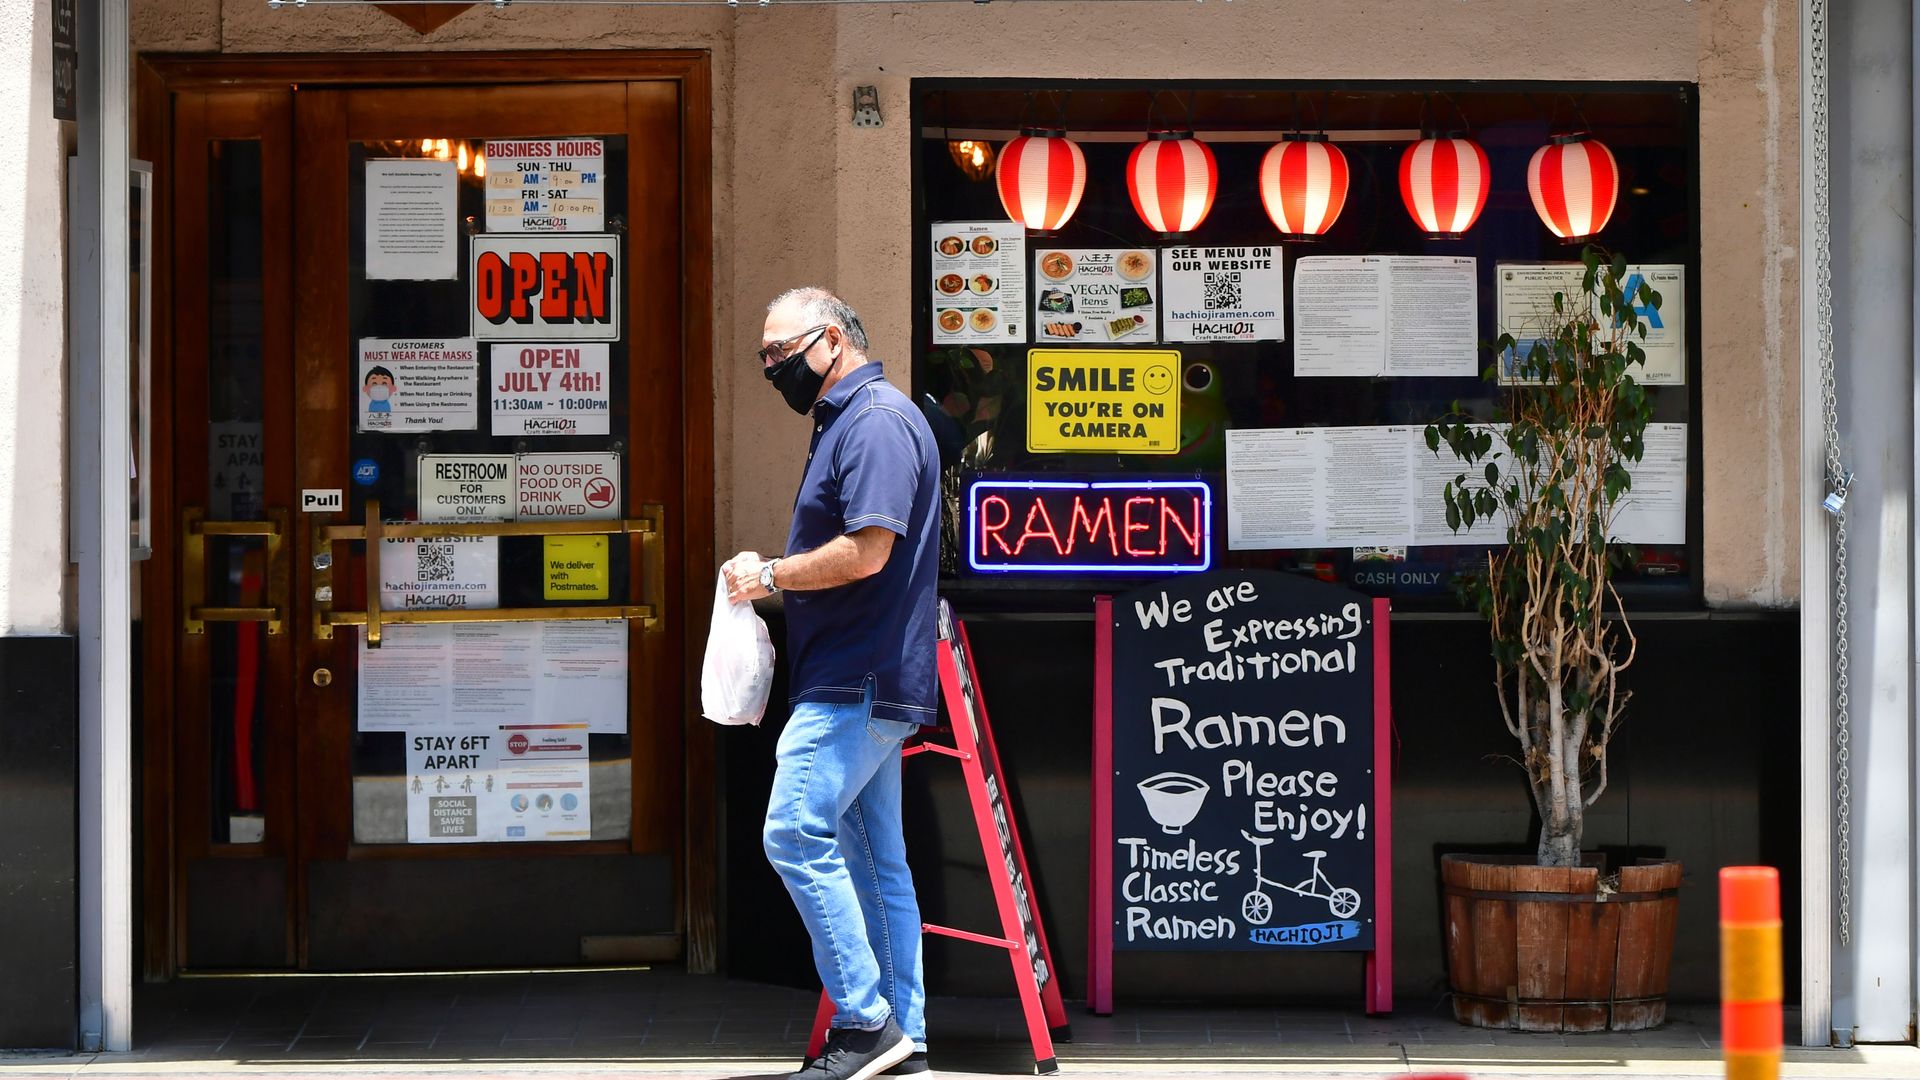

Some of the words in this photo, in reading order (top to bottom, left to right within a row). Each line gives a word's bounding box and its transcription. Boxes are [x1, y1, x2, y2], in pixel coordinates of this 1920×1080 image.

[487, 143, 552, 157] BUSINESS
[557, 142, 601, 156] HOURS
[517, 162, 539, 171] SUN
[549, 162, 572, 171] THU
[523, 174, 539, 184] AM
[581, 173, 596, 183] PM
[522, 190, 539, 199] FRI
[548, 190, 568, 199] SAT
[523, 201, 539, 211] AM
[582, 205, 594, 213] PM
[522, 217, 567, 227] HACHIOJI
[1080, 254, 1113, 263] 八王子
[1172, 249, 1198, 259] SEE
[1204, 248, 1246, 258] MENU
[1252, 247, 1271, 257] ON
[1172, 261, 1201, 271] OUR
[1208, 260, 1271, 270] WEBSITE
[477, 251, 612, 324] OPEN
[1070, 284, 1120, 295] VEGAN
[1081, 297, 1109, 306] items
[1610, 273, 1664, 328] A
[1172, 310, 1275, 320] hachiojiramen.com
[1192, 322, 1254, 336] HACHIOJI
[364, 351, 388, 360] MUST
[391, 351, 416, 360] WEAR
[419, 351, 440, 360] FACE
[442, 351, 472, 360] MASKS
[520, 348, 580, 369] OPEN
[498, 372, 552, 392] JULY
[560, 372, 601, 391] 4th!
[1035, 366, 1135, 392] SMILE
[493, 399, 543, 410] 11:30AM
[559, 398, 608, 410] 10:00PM
[1044, 401, 1123, 418] YOU'RE
[1132, 402, 1164, 418] ON
[524, 419, 577, 431] HACHIOJI
[1059, 422, 1148, 438] CAMERA
[218, 434, 258, 448] STAY
[357, 466, 376, 475] ADT
[435, 463, 507, 480] RESTROOM
[519, 464, 539, 475] NO
[544, 464, 603, 475] OUTSIDE
[460, 484, 483, 493] FOR
[520, 478, 558, 489] FOOD
[562, 478, 582, 488] OR
[304, 495, 339, 506] Pull
[437, 495, 506, 505] CUSTOMERS
[520, 491, 562, 502] DRINK
[456, 506, 486, 515] ONLY
[519, 505, 586, 515] ALLOWED
[981, 496, 1199, 556] RAMEN
[550, 561, 564, 569] We
[566, 561, 595, 569] deliver
[550, 572, 569, 580] with
[1354, 572, 1396, 585] CASH
[1400, 572, 1440, 584] ONLY
[385, 582, 487, 592] hachiojiramen.com
[550, 582, 599, 591] Postmates.
[405, 594, 467, 607] HACHIOJI
[1134, 591, 1192, 630] We
[1206, 581, 1258, 613] are
[1203, 602, 1362, 653] Expressing
[1154, 642, 1356, 687] Traditional
[1151, 697, 1346, 754] Ramen
[414, 736, 456, 751] STAY
[460, 736, 490, 750] 6FT
[424, 755, 480, 769] APART
[1222, 759, 1338, 797] Please
[438, 800, 467, 808] SOCIAL
[433, 808, 473, 816] DISTANCE
[440, 817, 465, 825] SAVES
[1254, 801, 1366, 841] Enjoy!
[1117, 837, 1241, 876] Timeless
[1122, 871, 1219, 903] Classic
[1126, 906, 1236, 942] Ramen
[1255, 923, 1344, 943] HACHIOJI
